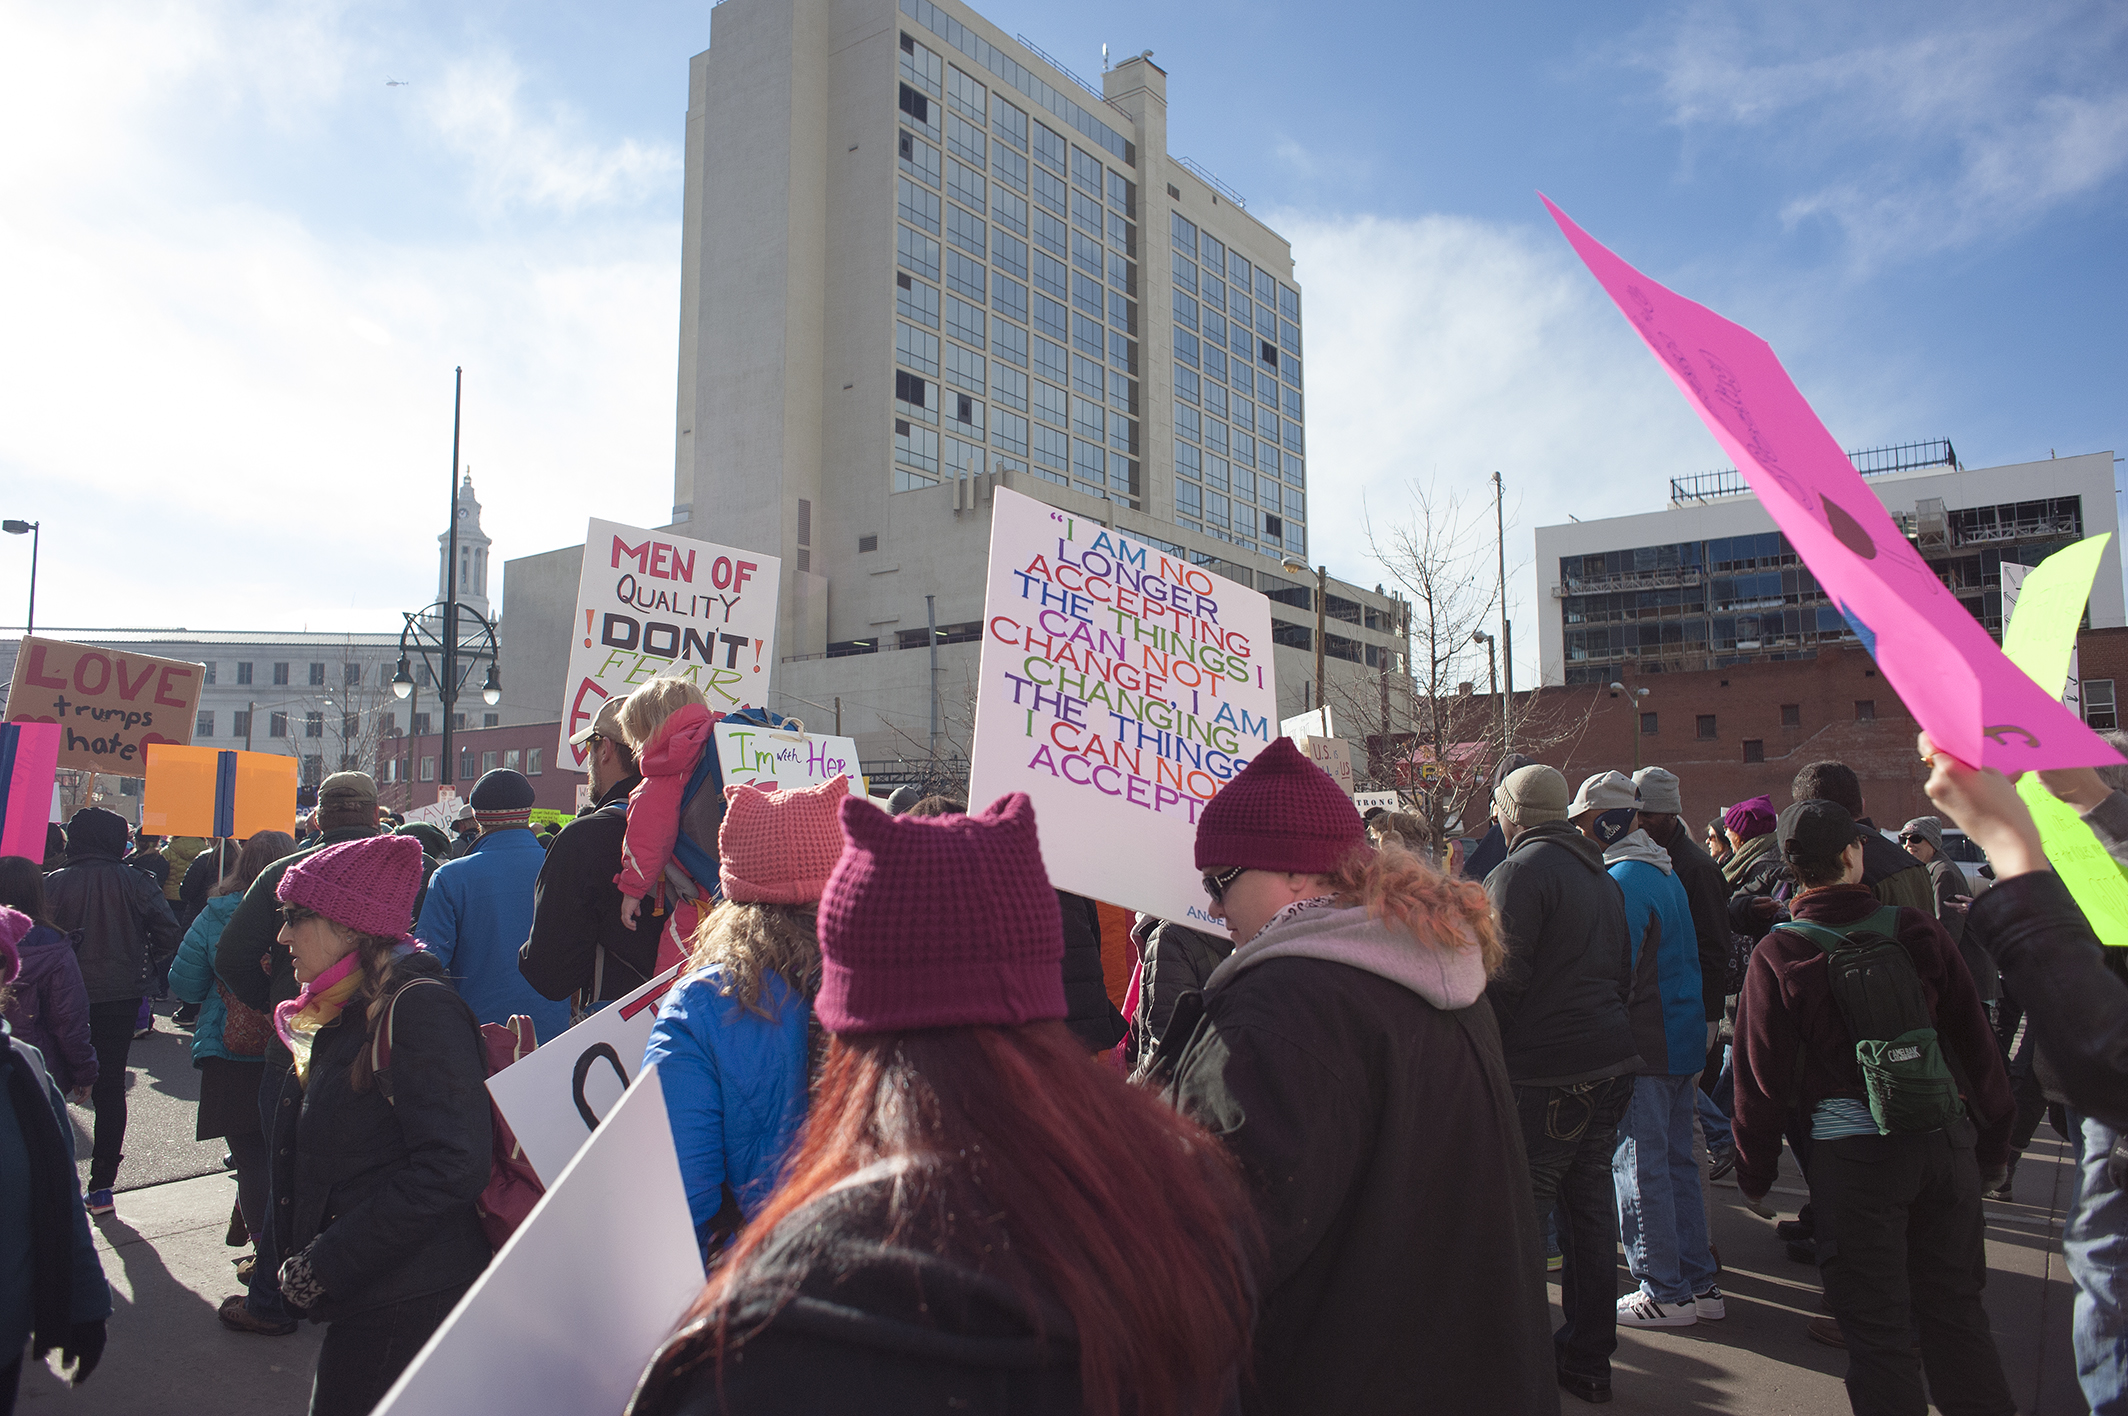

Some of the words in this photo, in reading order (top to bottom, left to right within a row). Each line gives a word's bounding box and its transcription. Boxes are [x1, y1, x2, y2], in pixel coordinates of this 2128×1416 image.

[611, 534, 696, 584] MEN
[711, 556, 758, 594] OF
[1057, 538, 1219, 625] LONGER
[1090, 531, 1147, 571] AM
[1160, 556, 1213, 596] NO
[617, 573, 741, 623] QUALITY
[1014, 569, 1094, 625] THE
[1107, 605, 1249, 683] THINGS
[1256, 664, 1264, 690] I
[1025, 554, 1251, 657] ACCEPTING
[601, 612, 749, 670] DON'T
[1039, 609, 1126, 662] CAN
[1143, 645, 1225, 697] NOT
[25, 644, 192, 708] LOVE
[990, 616, 1177, 710] CHANGE,
[1192, 689, 1200, 715] I
[1214, 701, 1269, 743] AM
[1004, 672, 1088, 730] THE
[1023, 656, 1239, 754] CHANGING
[53, 695, 153, 730] trumps
[66, 727, 138, 761] hate
[729, 732, 776, 775] I'm
[776, 748, 803, 764] with
[1026, 709, 1034, 737] I
[1050, 722, 1141, 776] CAN
[1156, 756, 1228, 800] NO
[1027, 744, 1204, 825] ACCEPT
[407, 797, 459, 822] SAVE
[433, 815, 453, 830] UR
